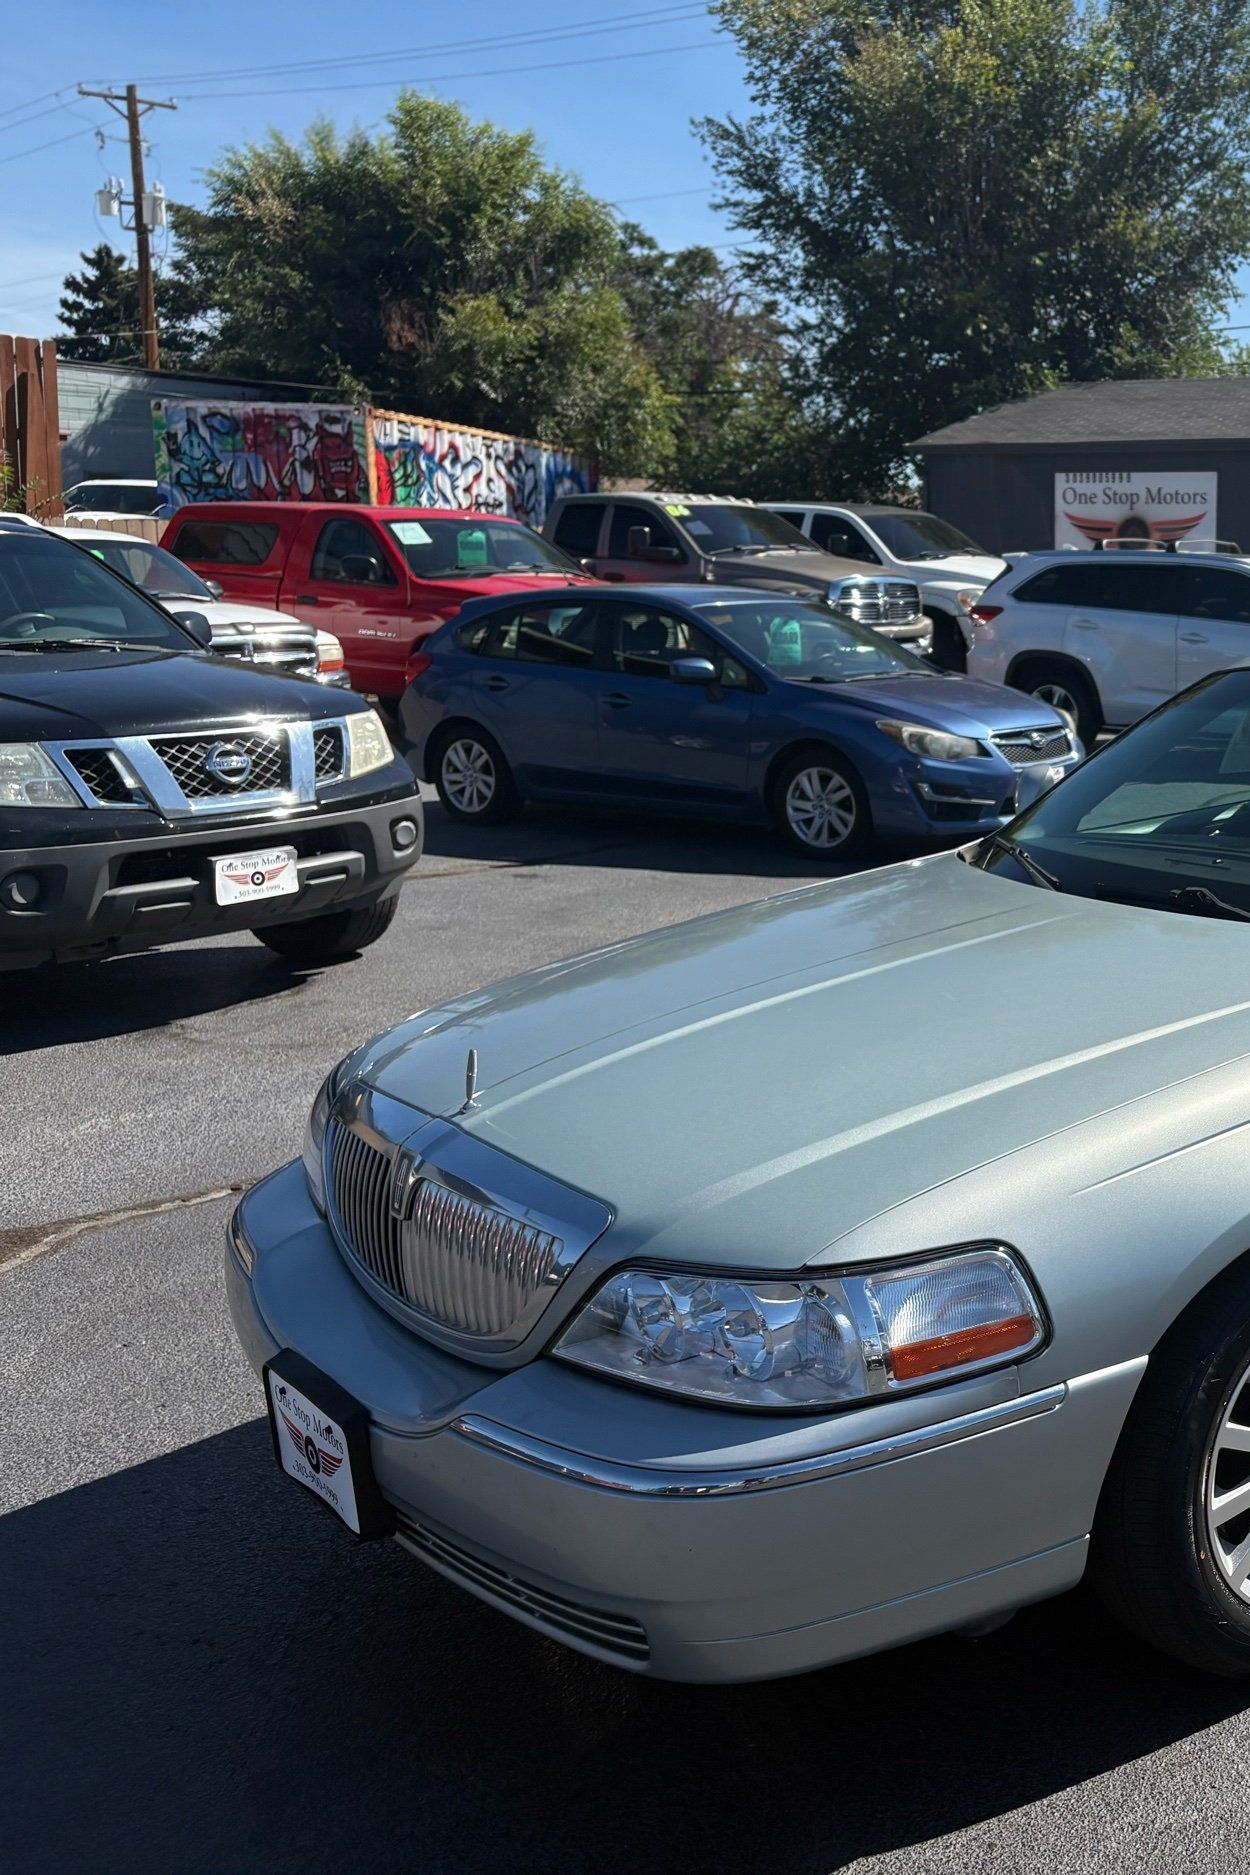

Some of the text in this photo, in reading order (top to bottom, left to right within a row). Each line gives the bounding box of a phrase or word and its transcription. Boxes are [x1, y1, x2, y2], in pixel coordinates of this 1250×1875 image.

[1062, 486, 1207, 510] One Stop Motors
[221, 863, 239, 873] One
[240, 860, 259, 870] Stop
[274, 1384, 344, 1455] One Stop Motors
